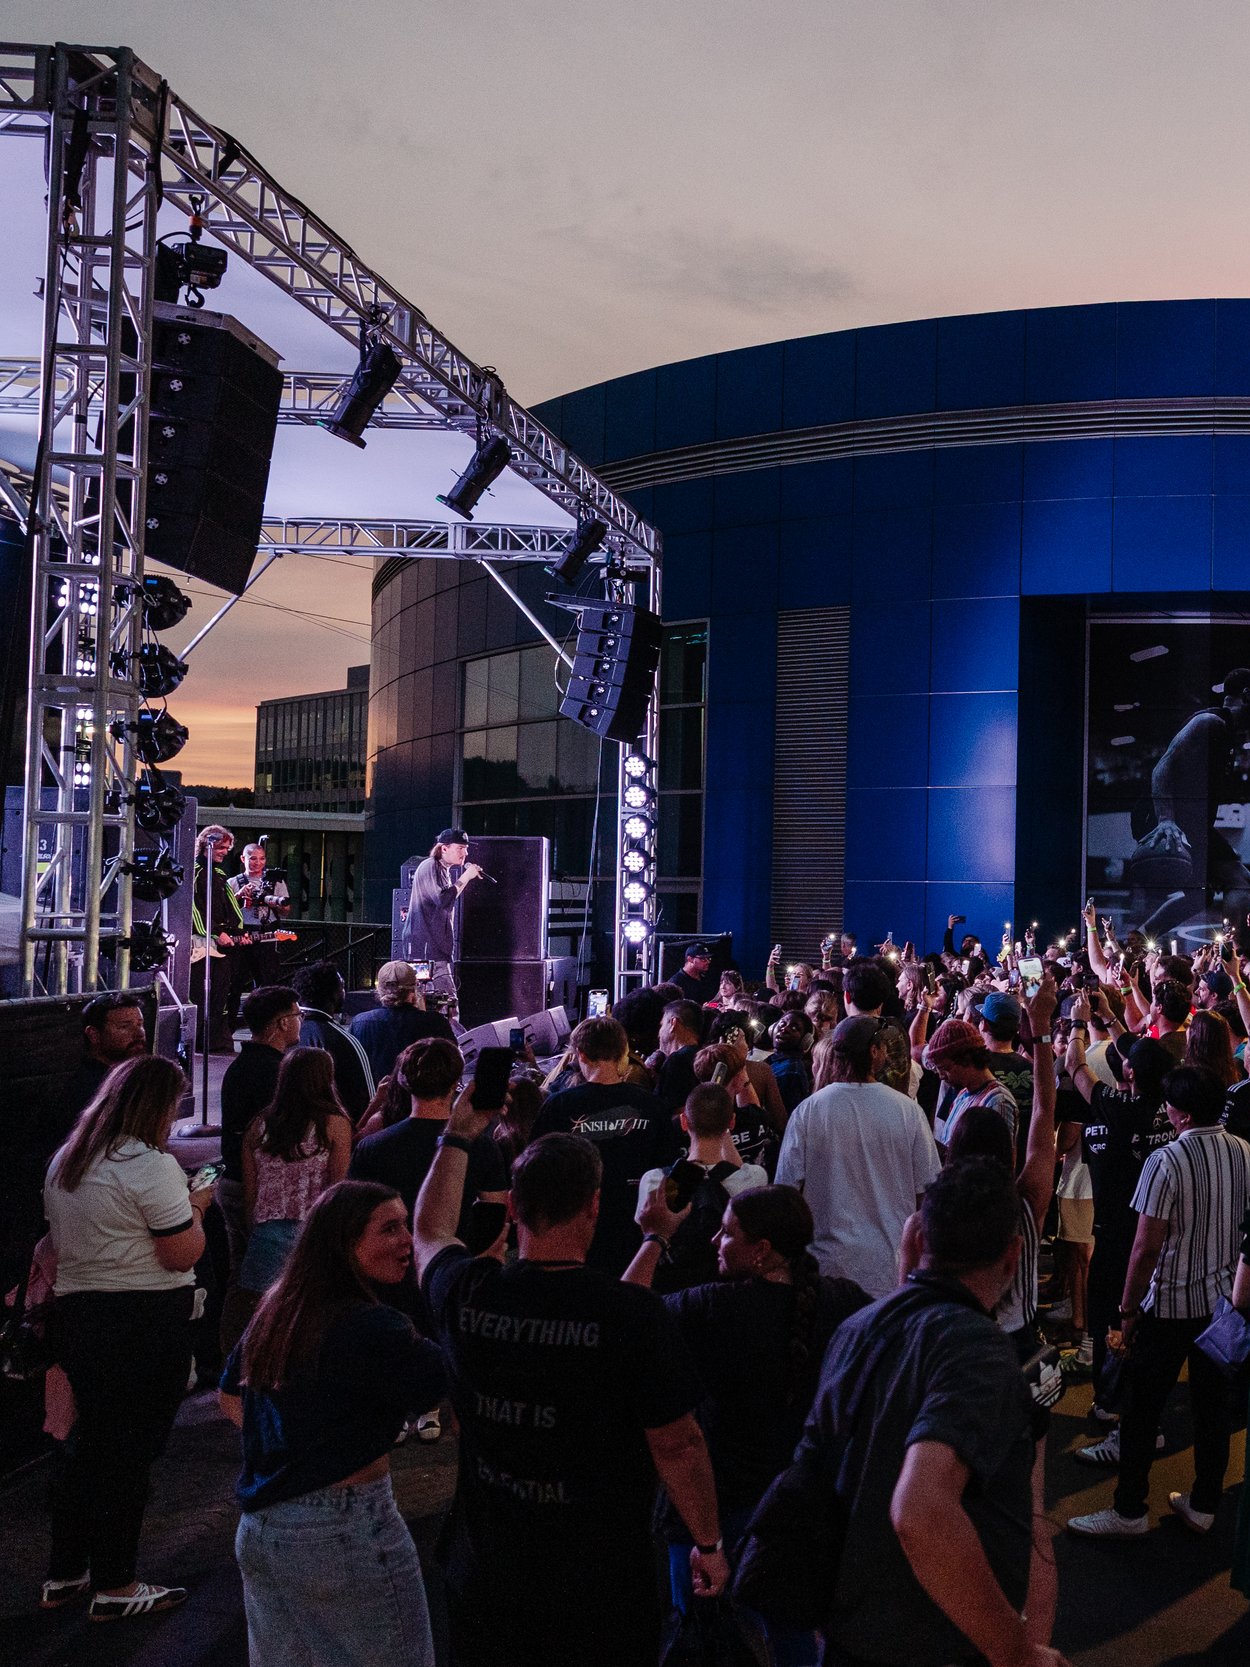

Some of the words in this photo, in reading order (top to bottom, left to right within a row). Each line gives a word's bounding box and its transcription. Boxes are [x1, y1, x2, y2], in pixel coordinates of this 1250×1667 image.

[458, 1306, 601, 1348] EVERYTHING
[474, 1391, 527, 1426] THAT
[533, 1404, 557, 1430] IS
